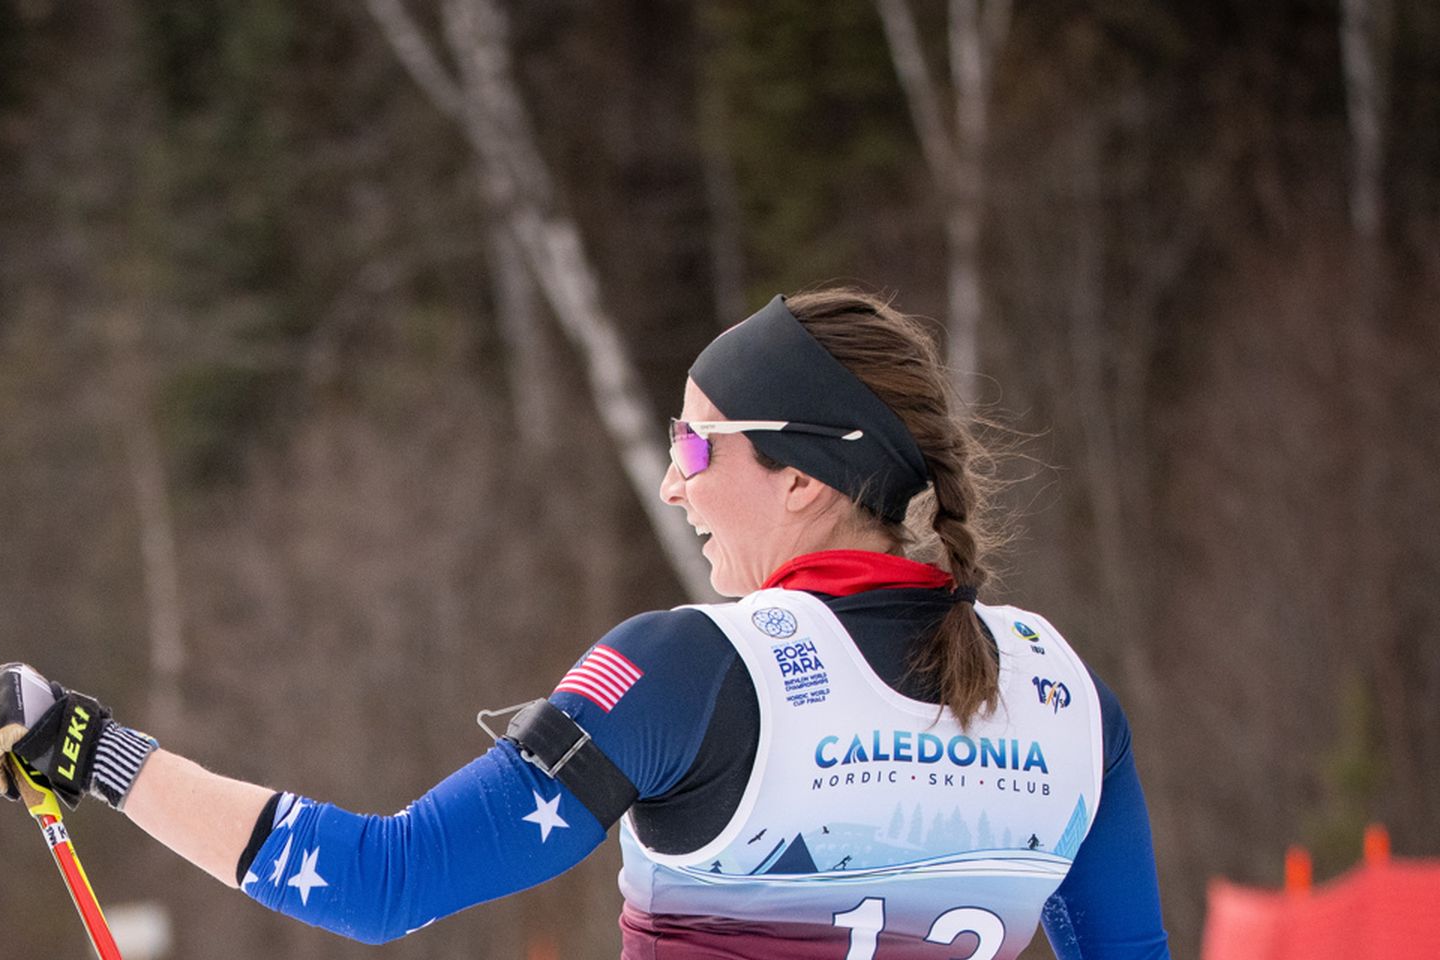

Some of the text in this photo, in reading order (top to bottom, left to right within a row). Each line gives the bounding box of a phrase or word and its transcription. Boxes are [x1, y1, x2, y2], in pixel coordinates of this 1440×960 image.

[773, 640, 817, 662] 2024
[779, 655, 824, 677] PARA
[58, 706, 90, 781] LEKI
[814, 730, 1050, 775] CALEDONIA
[812, 770, 1051, 797] NORDIC SKI CLUB
